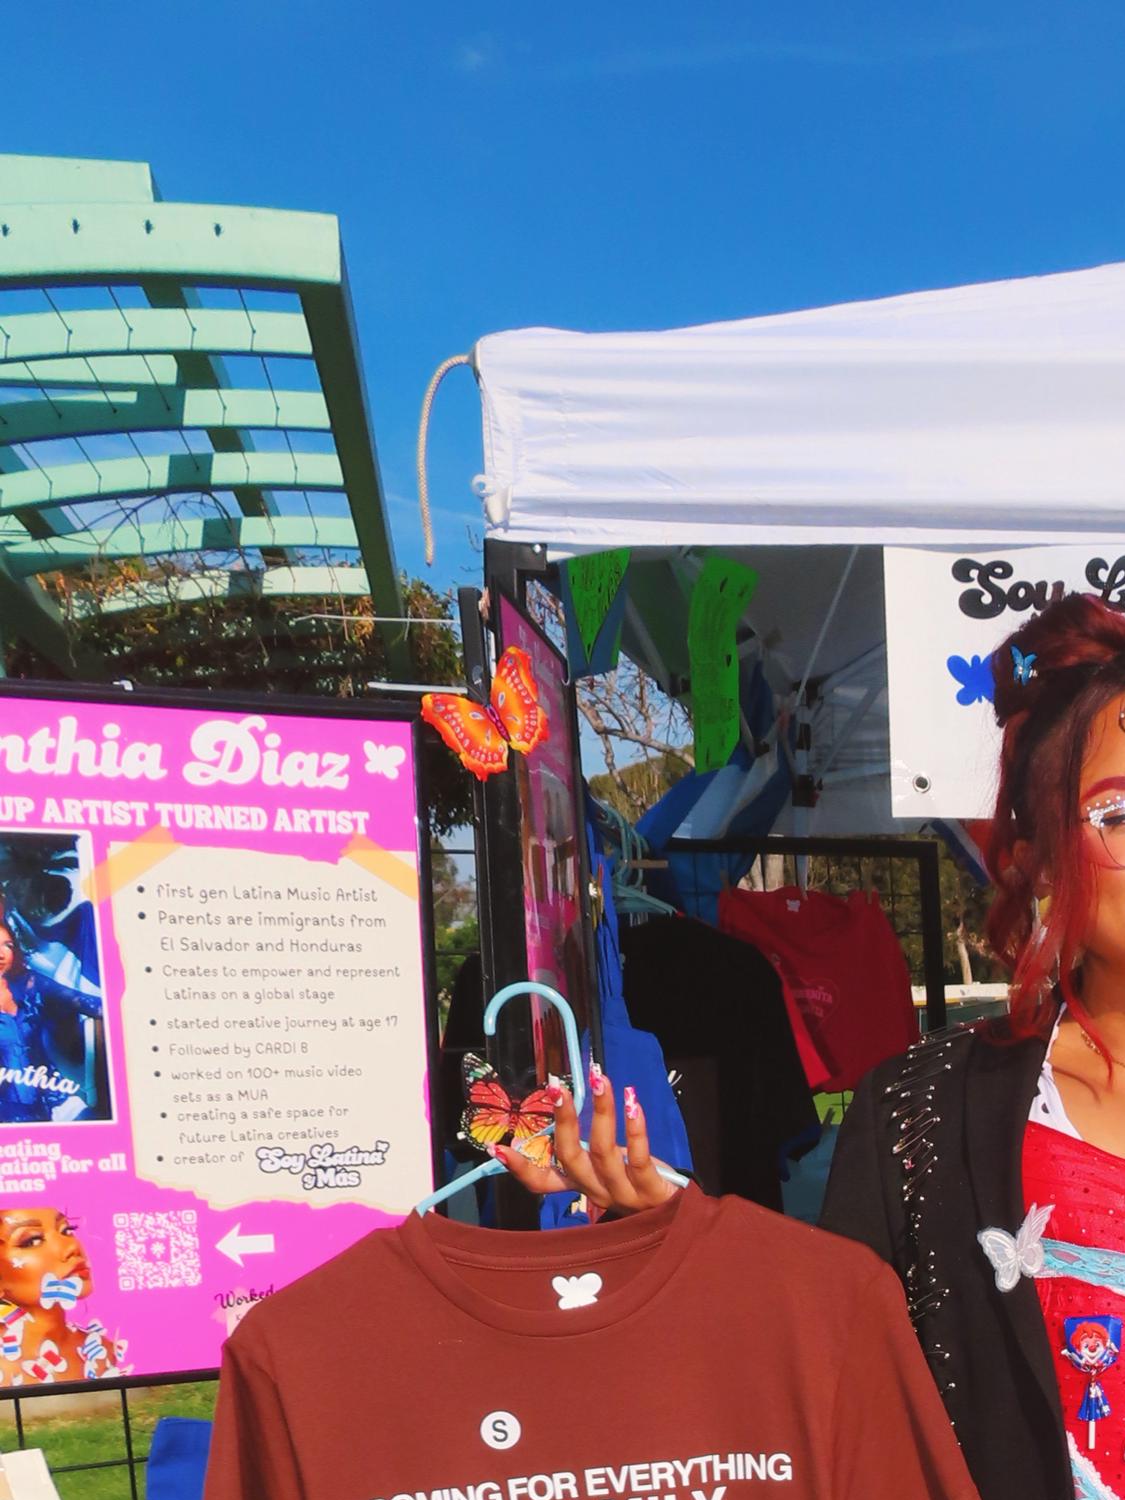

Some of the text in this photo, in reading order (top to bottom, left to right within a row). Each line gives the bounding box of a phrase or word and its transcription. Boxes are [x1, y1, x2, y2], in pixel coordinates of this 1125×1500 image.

[183, 715, 351, 790] Diaz
[42, 797, 149, 827] ARTIST
[156, 804, 269, 832] TURNED
[273, 809, 370, 836] ARTIST
[199, 887, 228, 904] gen
[233, 885, 282, 900] Latina
[286, 887, 331, 902] Music
[336, 887, 378, 903] Artist
[157, 910, 386, 932] Parents are immigrants from
[160, 937, 363, 953] El Salvador and Honduras
[162, 964, 401, 982] Creates to empower and represent
[164, 987, 336, 1005] Latinas on a global stage
[167, 1015, 398, 1032] started creative journey at age 17
[169, 1042, 308, 1058] Followed by CARDI B
[171, 1065, 363, 1081] worked on 100+ music video
[173, 1089, 269, 1103] sets as a MUA
[177, 1105, 350, 1124] creating a safe space for
[178, 1127, 339, 1145] future Latina creatives
[0, 1138, 61, 1161] ating
[173, 1151, 245, 1165] creator of
[256, 1142, 385, 1175] Soy Latina
[61, 1155, 94, 1173] for
[98, 1152, 128, 1172] all
[491, 1418, 509, 1443] S
[584, 1452, 793, 1497] EVERYTHING
